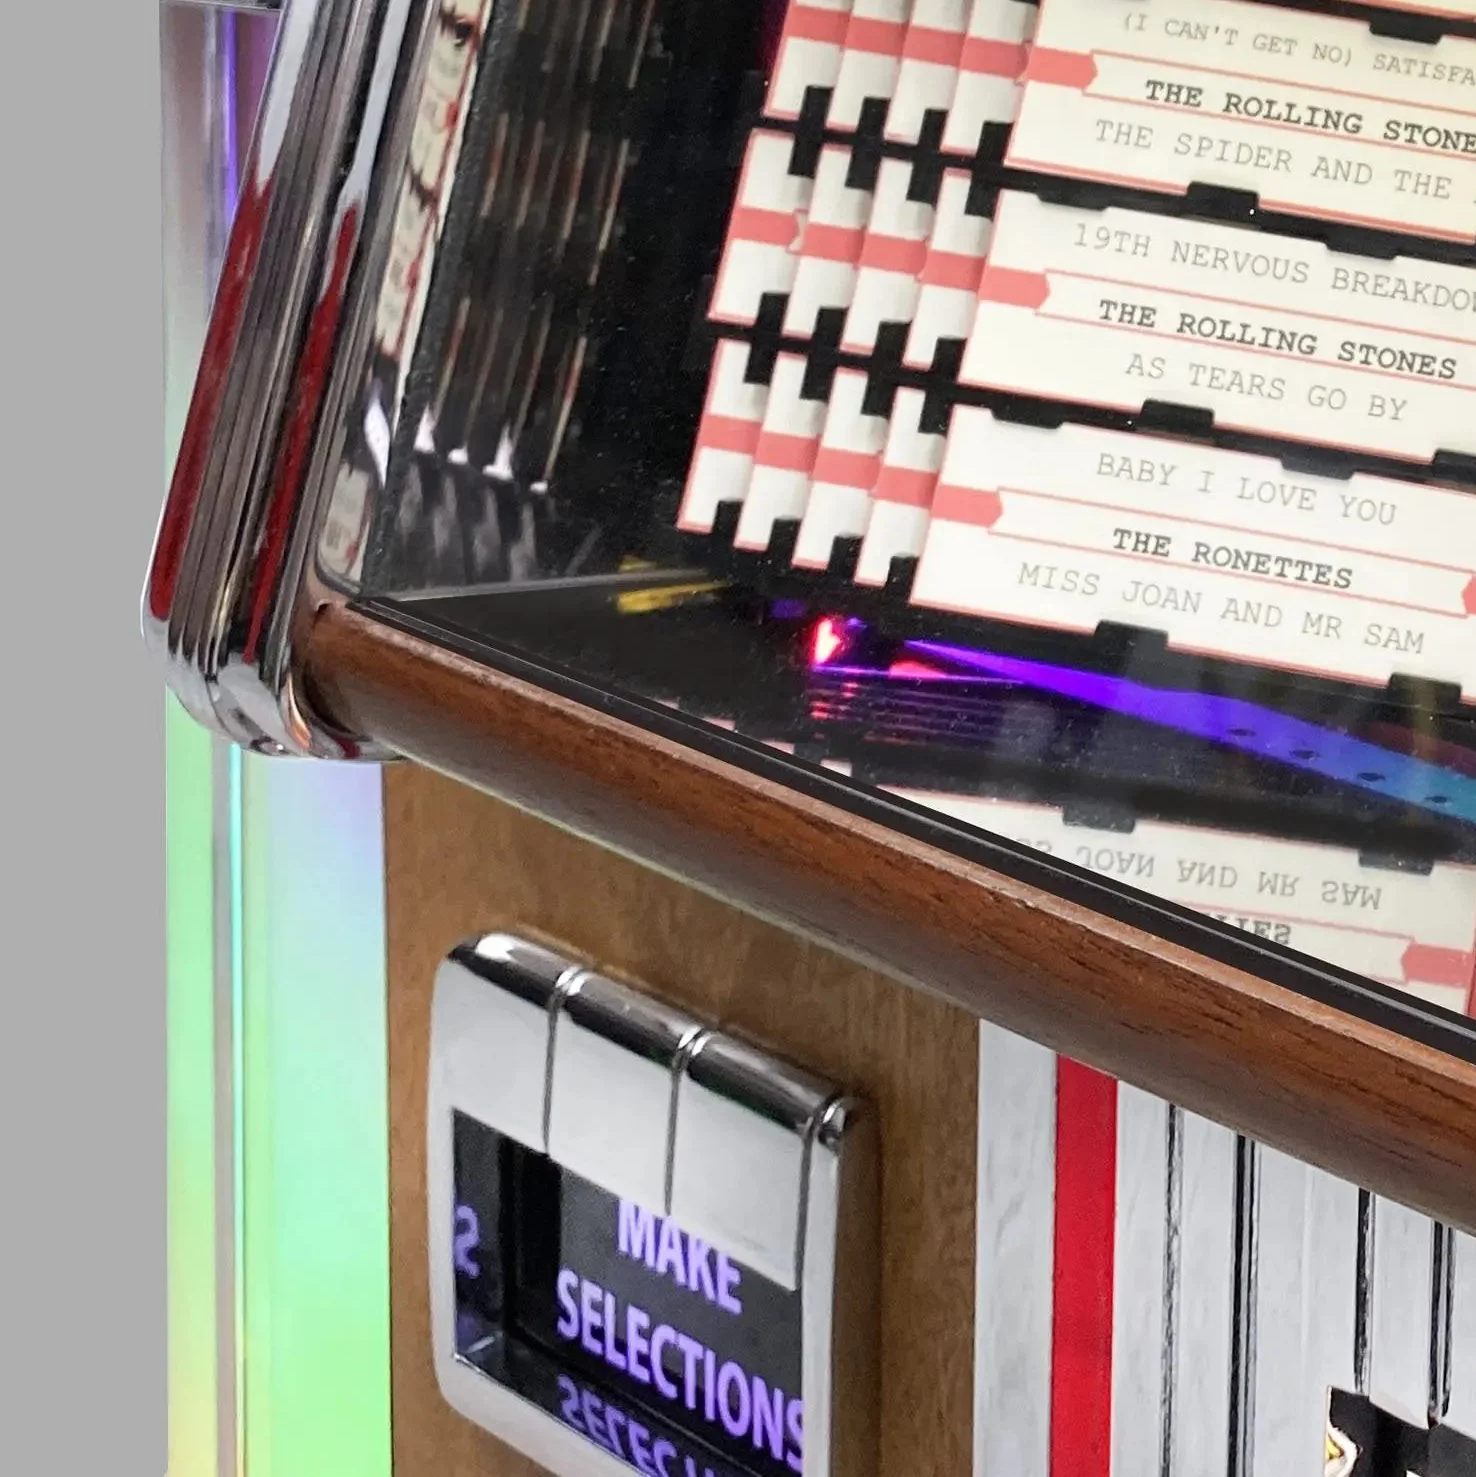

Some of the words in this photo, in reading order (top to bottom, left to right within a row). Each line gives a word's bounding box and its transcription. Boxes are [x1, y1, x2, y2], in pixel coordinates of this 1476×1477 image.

[1163, 17, 1240, 47] CAN'T
[1251, 32, 1297, 57] GET
[1311, 41, 1355, 71] NO)
[1145, 79, 1203, 110] THE
[1222, 93, 1364, 136] ROLLING
[1095, 119, 1154, 150] THE
[1172, 131, 1293, 174] SPIDER
[1310, 155, 1373, 188] AND
[1393, 170, 1453, 200] THE
[1073, 223, 1151, 259] 19TH
[1171, 239, 1311, 285] NERVOUS
[1099, 298, 1158, 330] THE
[1176, 311, 1318, 357] ROLLING
[1338, 341, 1458, 382] STONES
[1124, 353, 1167, 380] AS
[1188, 362, 1286, 402] TEARS
[1307, 384, 1349, 412] GO
[1366, 393, 1408, 423] BY
[1096, 452, 1176, 487] BABY
[1196, 469, 1214, 493] I
[1236, 476, 1319, 512] LOVE
[1339, 495, 1398, 526] YOU
[1112, 528, 1171, 558] THE
[1192, 540, 1354, 591] RONETTES
[1016, 561, 1100, 596] MISS
[1121, 578, 1204, 615] JOAN
[1219, 597, 1283, 629] AND
[1301, 611, 1344, 640] MR
[1363, 622, 1425, 656] SAM
[617, 1198, 742, 1314] MAKE
